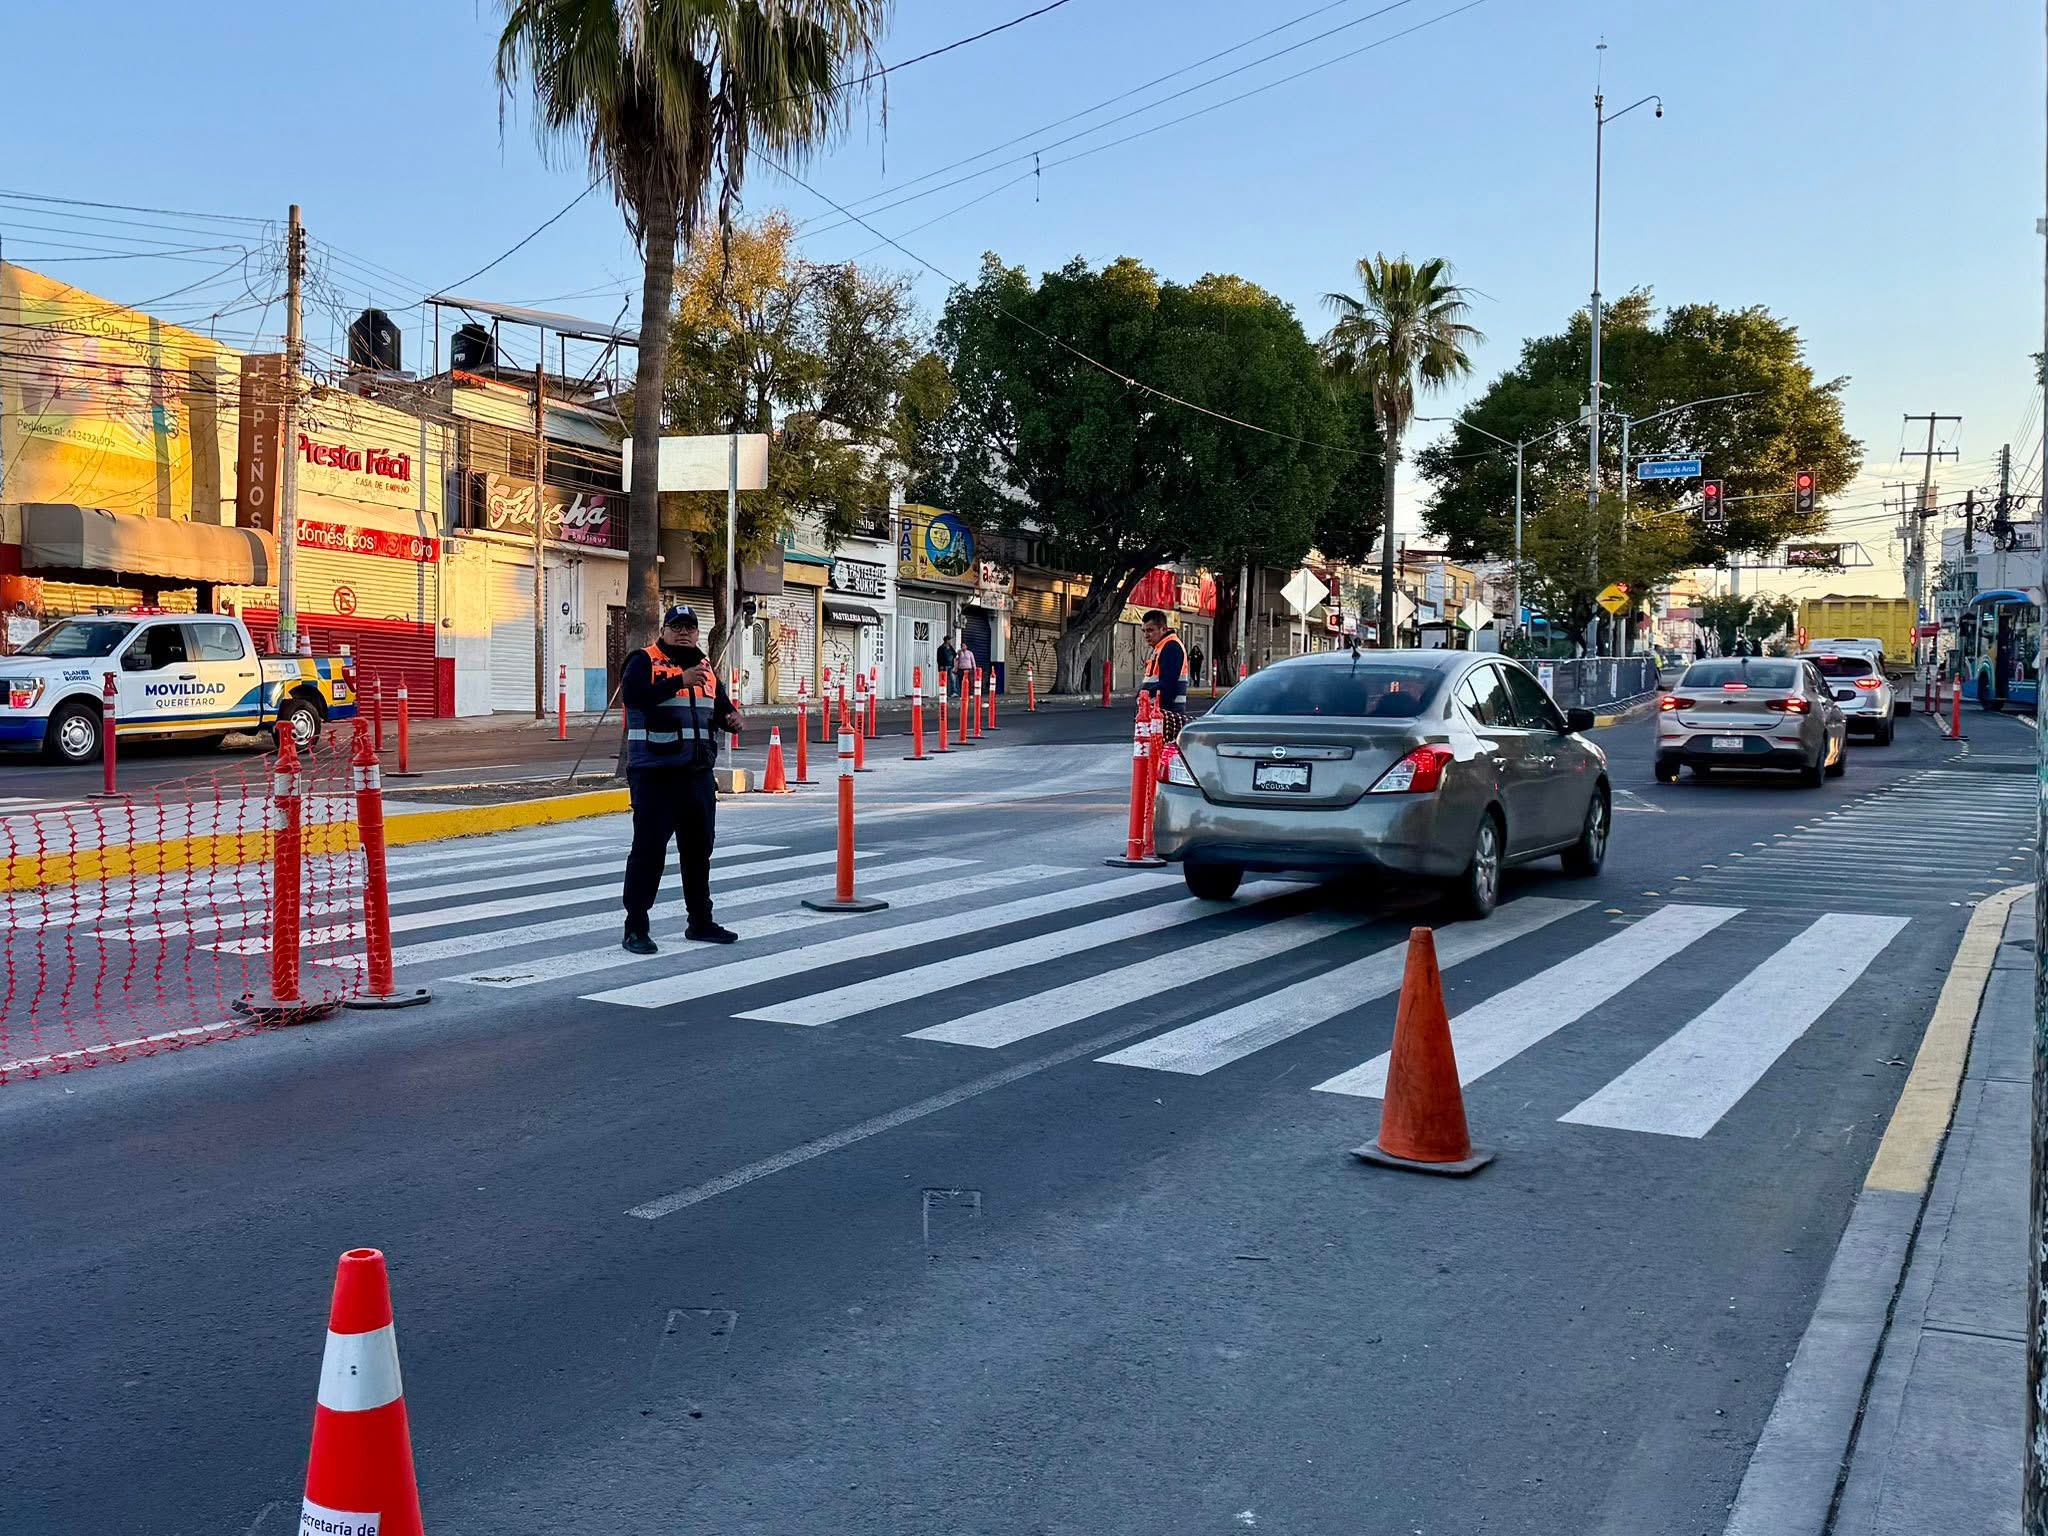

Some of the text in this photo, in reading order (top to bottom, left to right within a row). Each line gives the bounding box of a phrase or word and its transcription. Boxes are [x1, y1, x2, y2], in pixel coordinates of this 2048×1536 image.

[17, 418, 53, 435] Pedidos
[249, 359, 267, 528] EMPEÑOS
[297, 432, 411, 481] Presta Fácil
[355, 478, 373, 488] CASA
[374, 480, 384, 490] DE
[410, 539, 433, 558] Oro
[900, 518, 913, 561] BAR
[855, 578, 879, 593] SUKHA
[145, 683, 226, 697] MOVILIDAD
[155, 697, 216, 709] QUERÉTARO
[301, 1508, 376, 1536] ecretaría de
